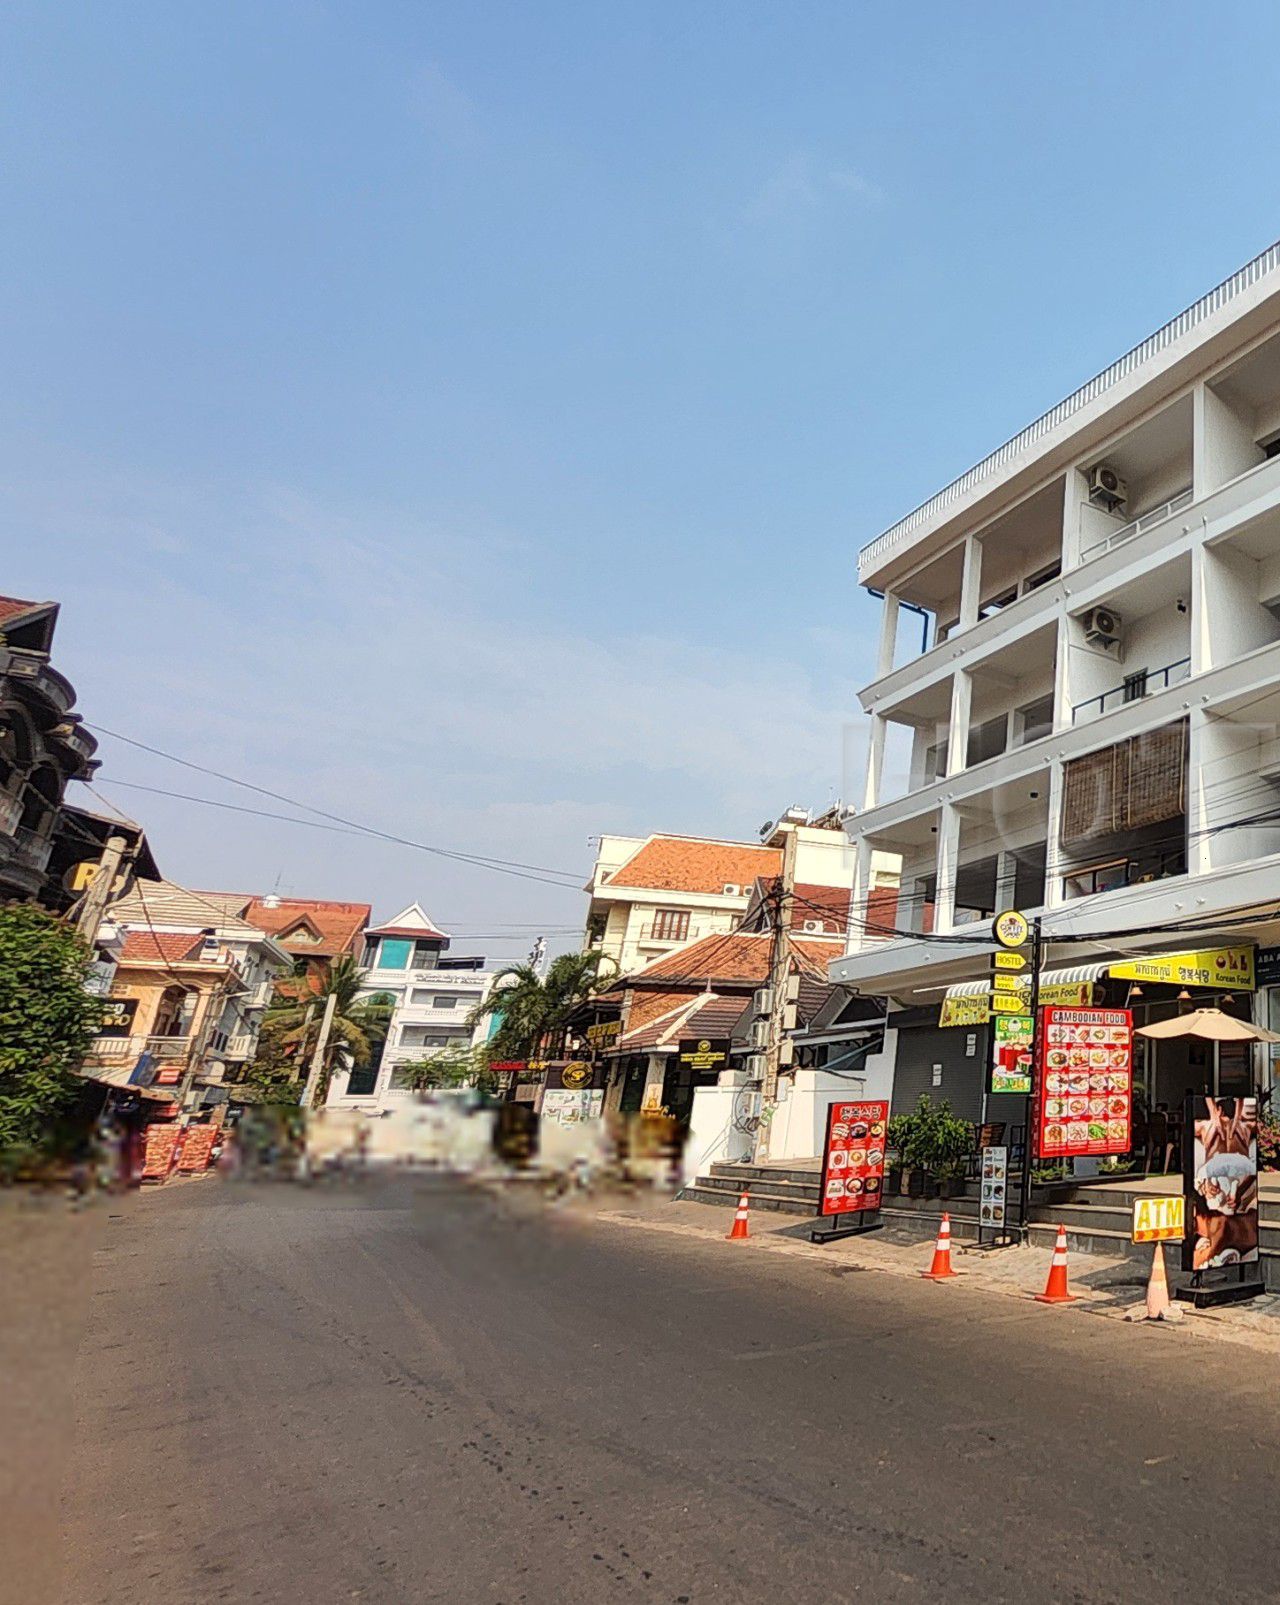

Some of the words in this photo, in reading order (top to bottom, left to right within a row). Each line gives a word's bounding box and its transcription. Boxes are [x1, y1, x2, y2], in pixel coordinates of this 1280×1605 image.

[996, 955, 1022, 966] HOSTEL
[1178, 966, 1210, 984] 행복식당
[1215, 973, 1236, 983] Korean
[1236, 975, 1251, 985] Food
[1038, 990, 1059, 1000] orean
[1060, 987, 1079, 998] Food
[1052, 1010, 1103, 1024] CAMBODIAN
[1105, 1012, 1126, 1025] FOOD
[841, 1105, 883, 1121] 행복식당
[1136, 1200, 1182, 1229] ATM
